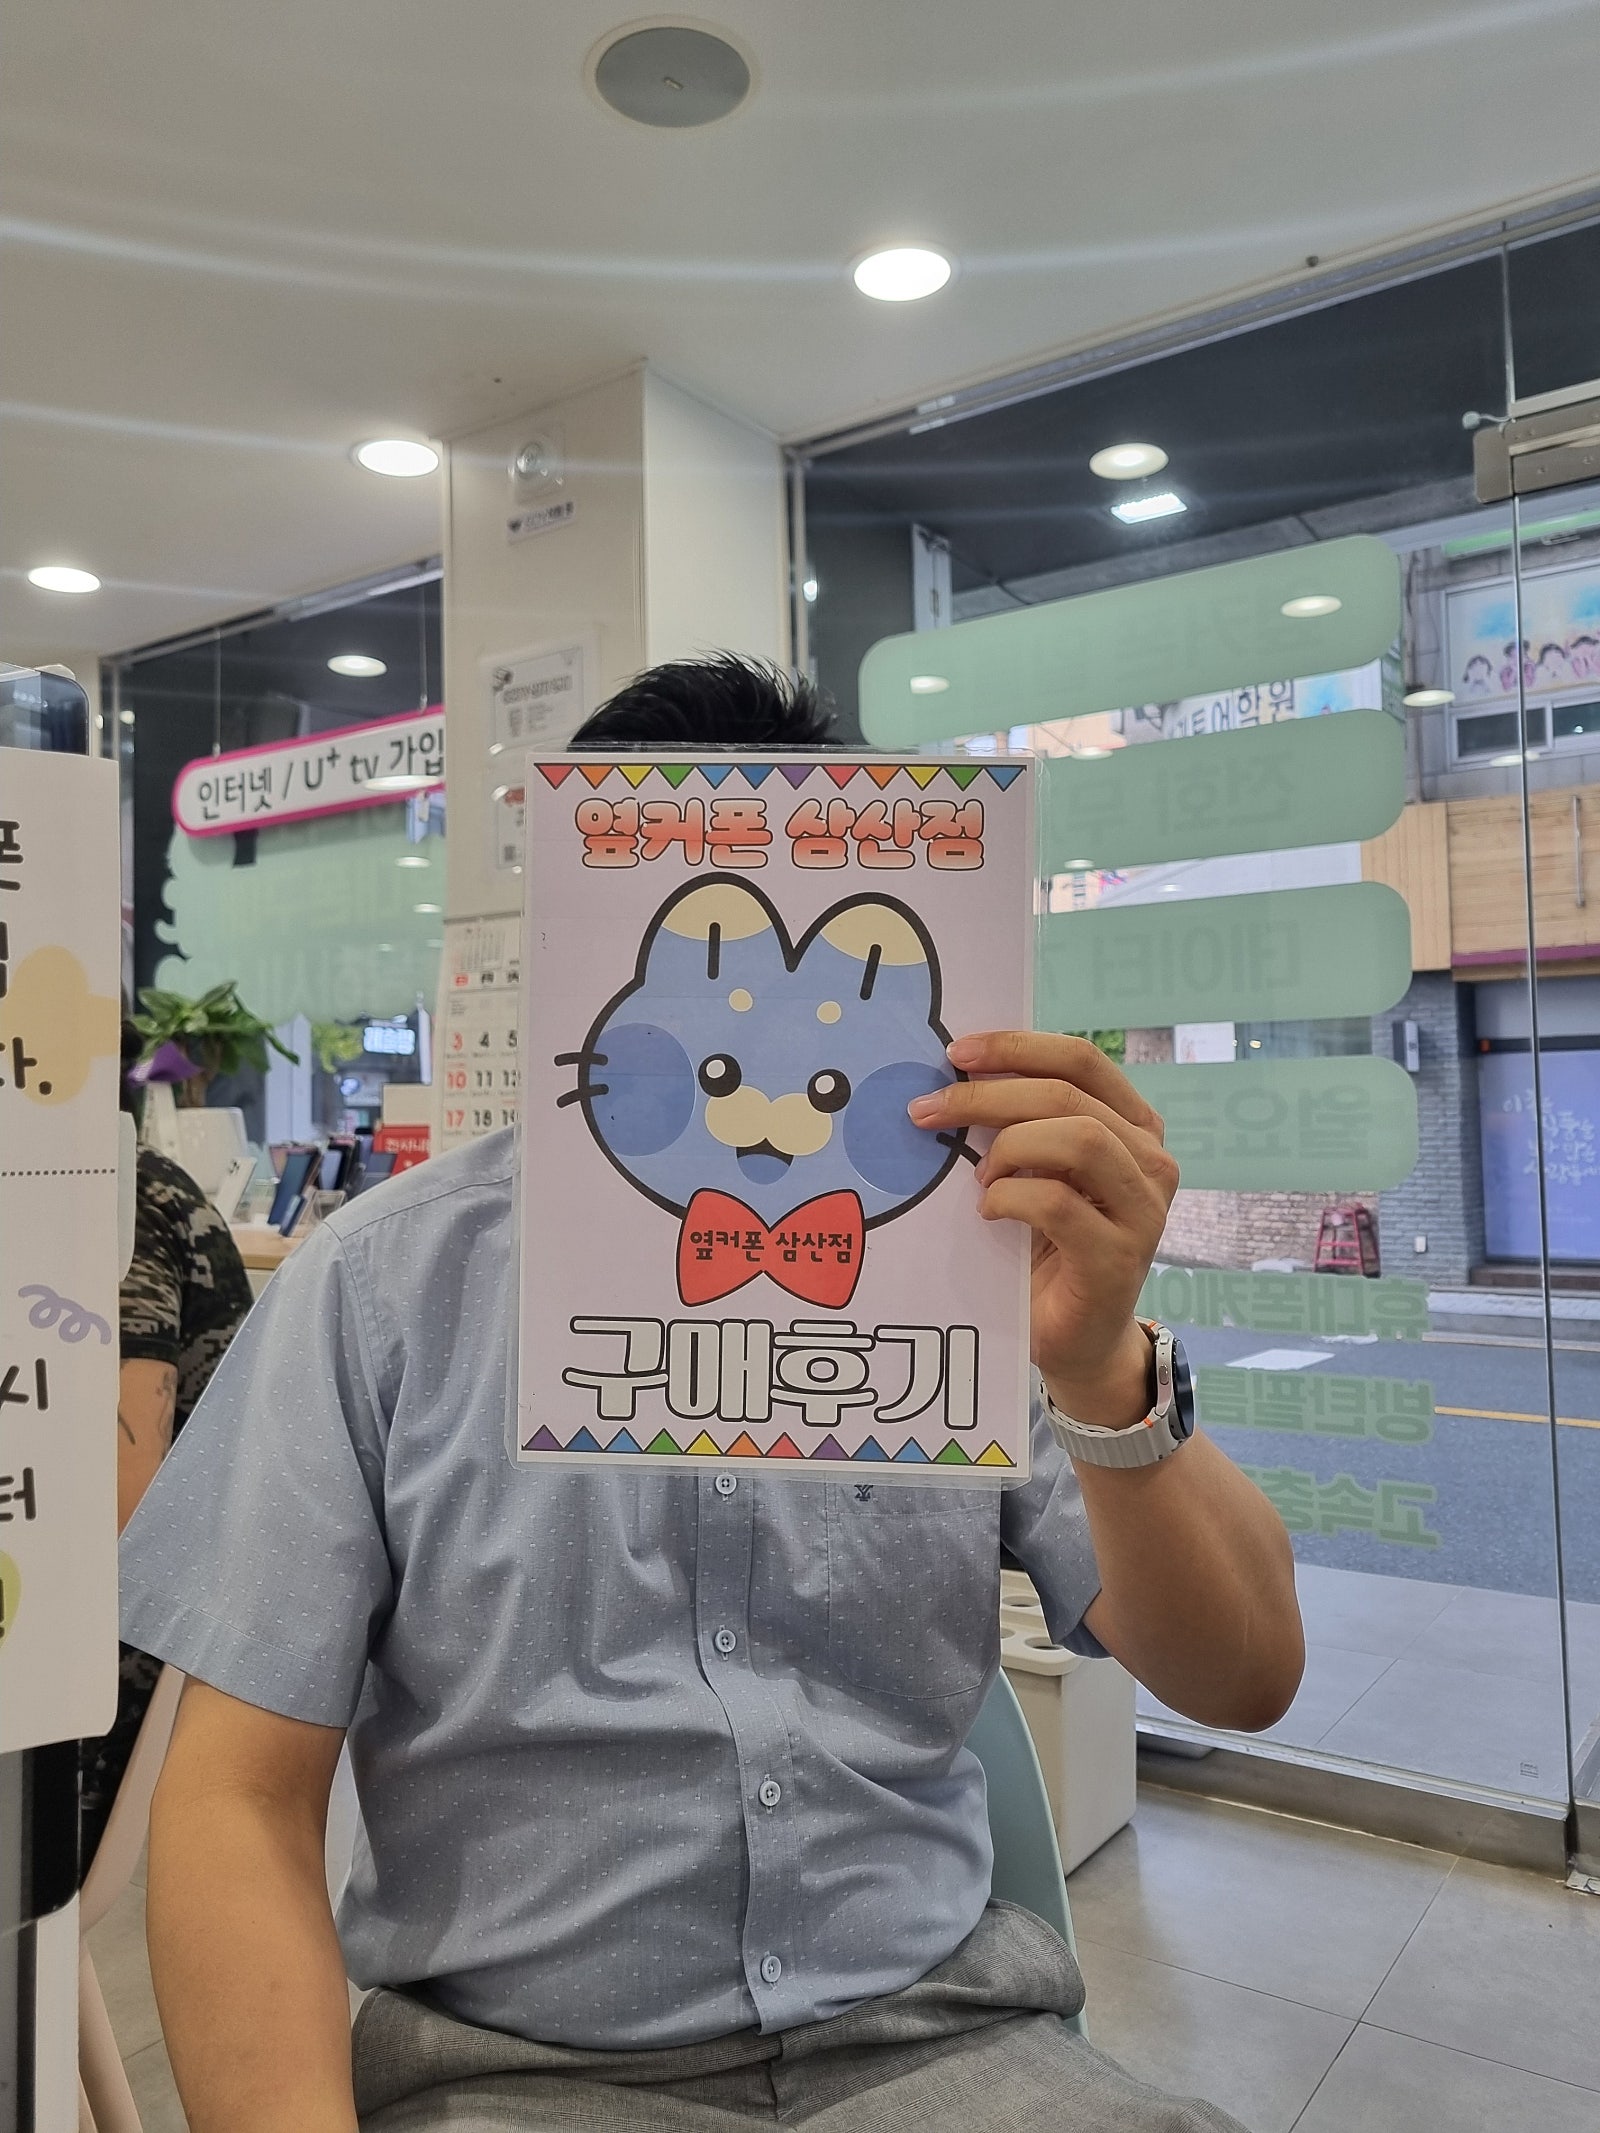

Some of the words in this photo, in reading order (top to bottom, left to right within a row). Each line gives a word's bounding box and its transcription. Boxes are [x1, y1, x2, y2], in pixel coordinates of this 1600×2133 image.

[199, 765, 273, 821] 인터넷
[350, 755, 380, 784] tv
[391, 728, 444, 778] 가입
[574, 796, 774, 869] 옆커폰
[784, 797, 986, 871] 삼산점
[453, 1032, 464, 1051] 3
[479, 1031, 490, 1049] 4
[507, 1029, 518, 1048] 5
[447, 1071, 467, 1089] 10
[476, 1071, 493, 1088] 11
[446, 1109, 465, 1128] 17
[473, 1109, 492, 1128] 18
[689, 1229, 765, 1263] 옆커폰
[775, 1231, 854, 1264] 삼산점
[562, 1315, 979, 1430] 구매후기
